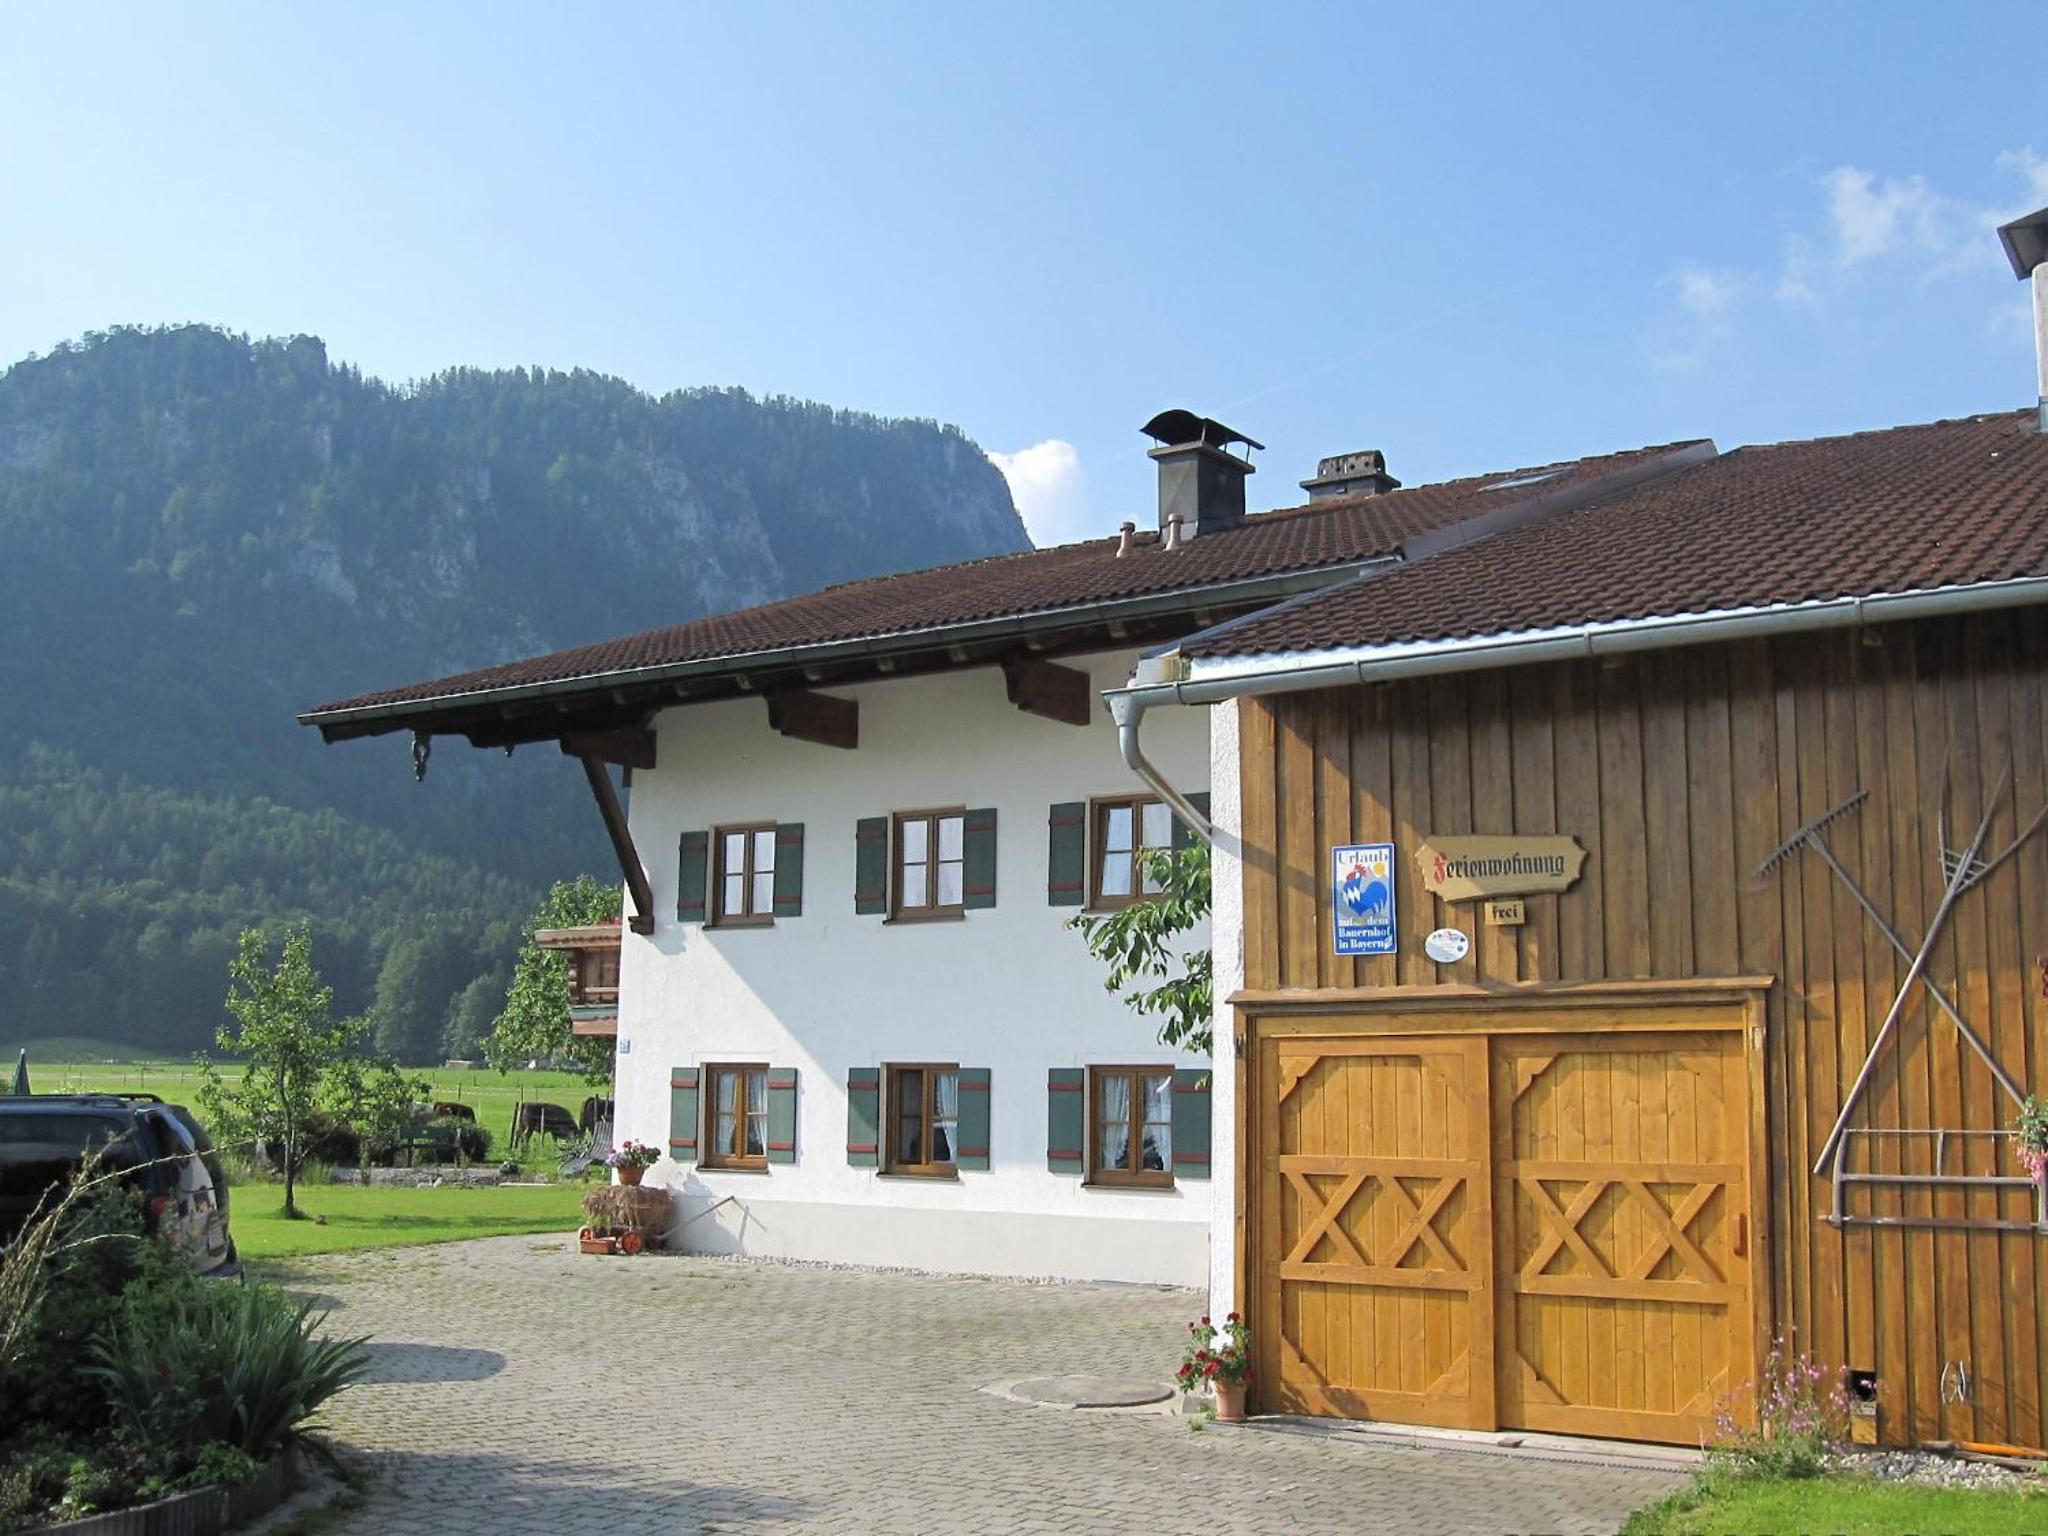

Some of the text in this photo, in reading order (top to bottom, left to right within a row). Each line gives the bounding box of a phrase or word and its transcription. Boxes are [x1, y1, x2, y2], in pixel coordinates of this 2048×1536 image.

[1338, 850, 1388, 864] Urlaub
[1433, 852, 1565, 884] Ferienwohnung
[1492, 904, 1518, 919] frei
[1367, 916, 1388, 926] dem
[1338, 926, 1390, 938] Bauernhof
[1338, 938, 1384, 951] in Bayern
